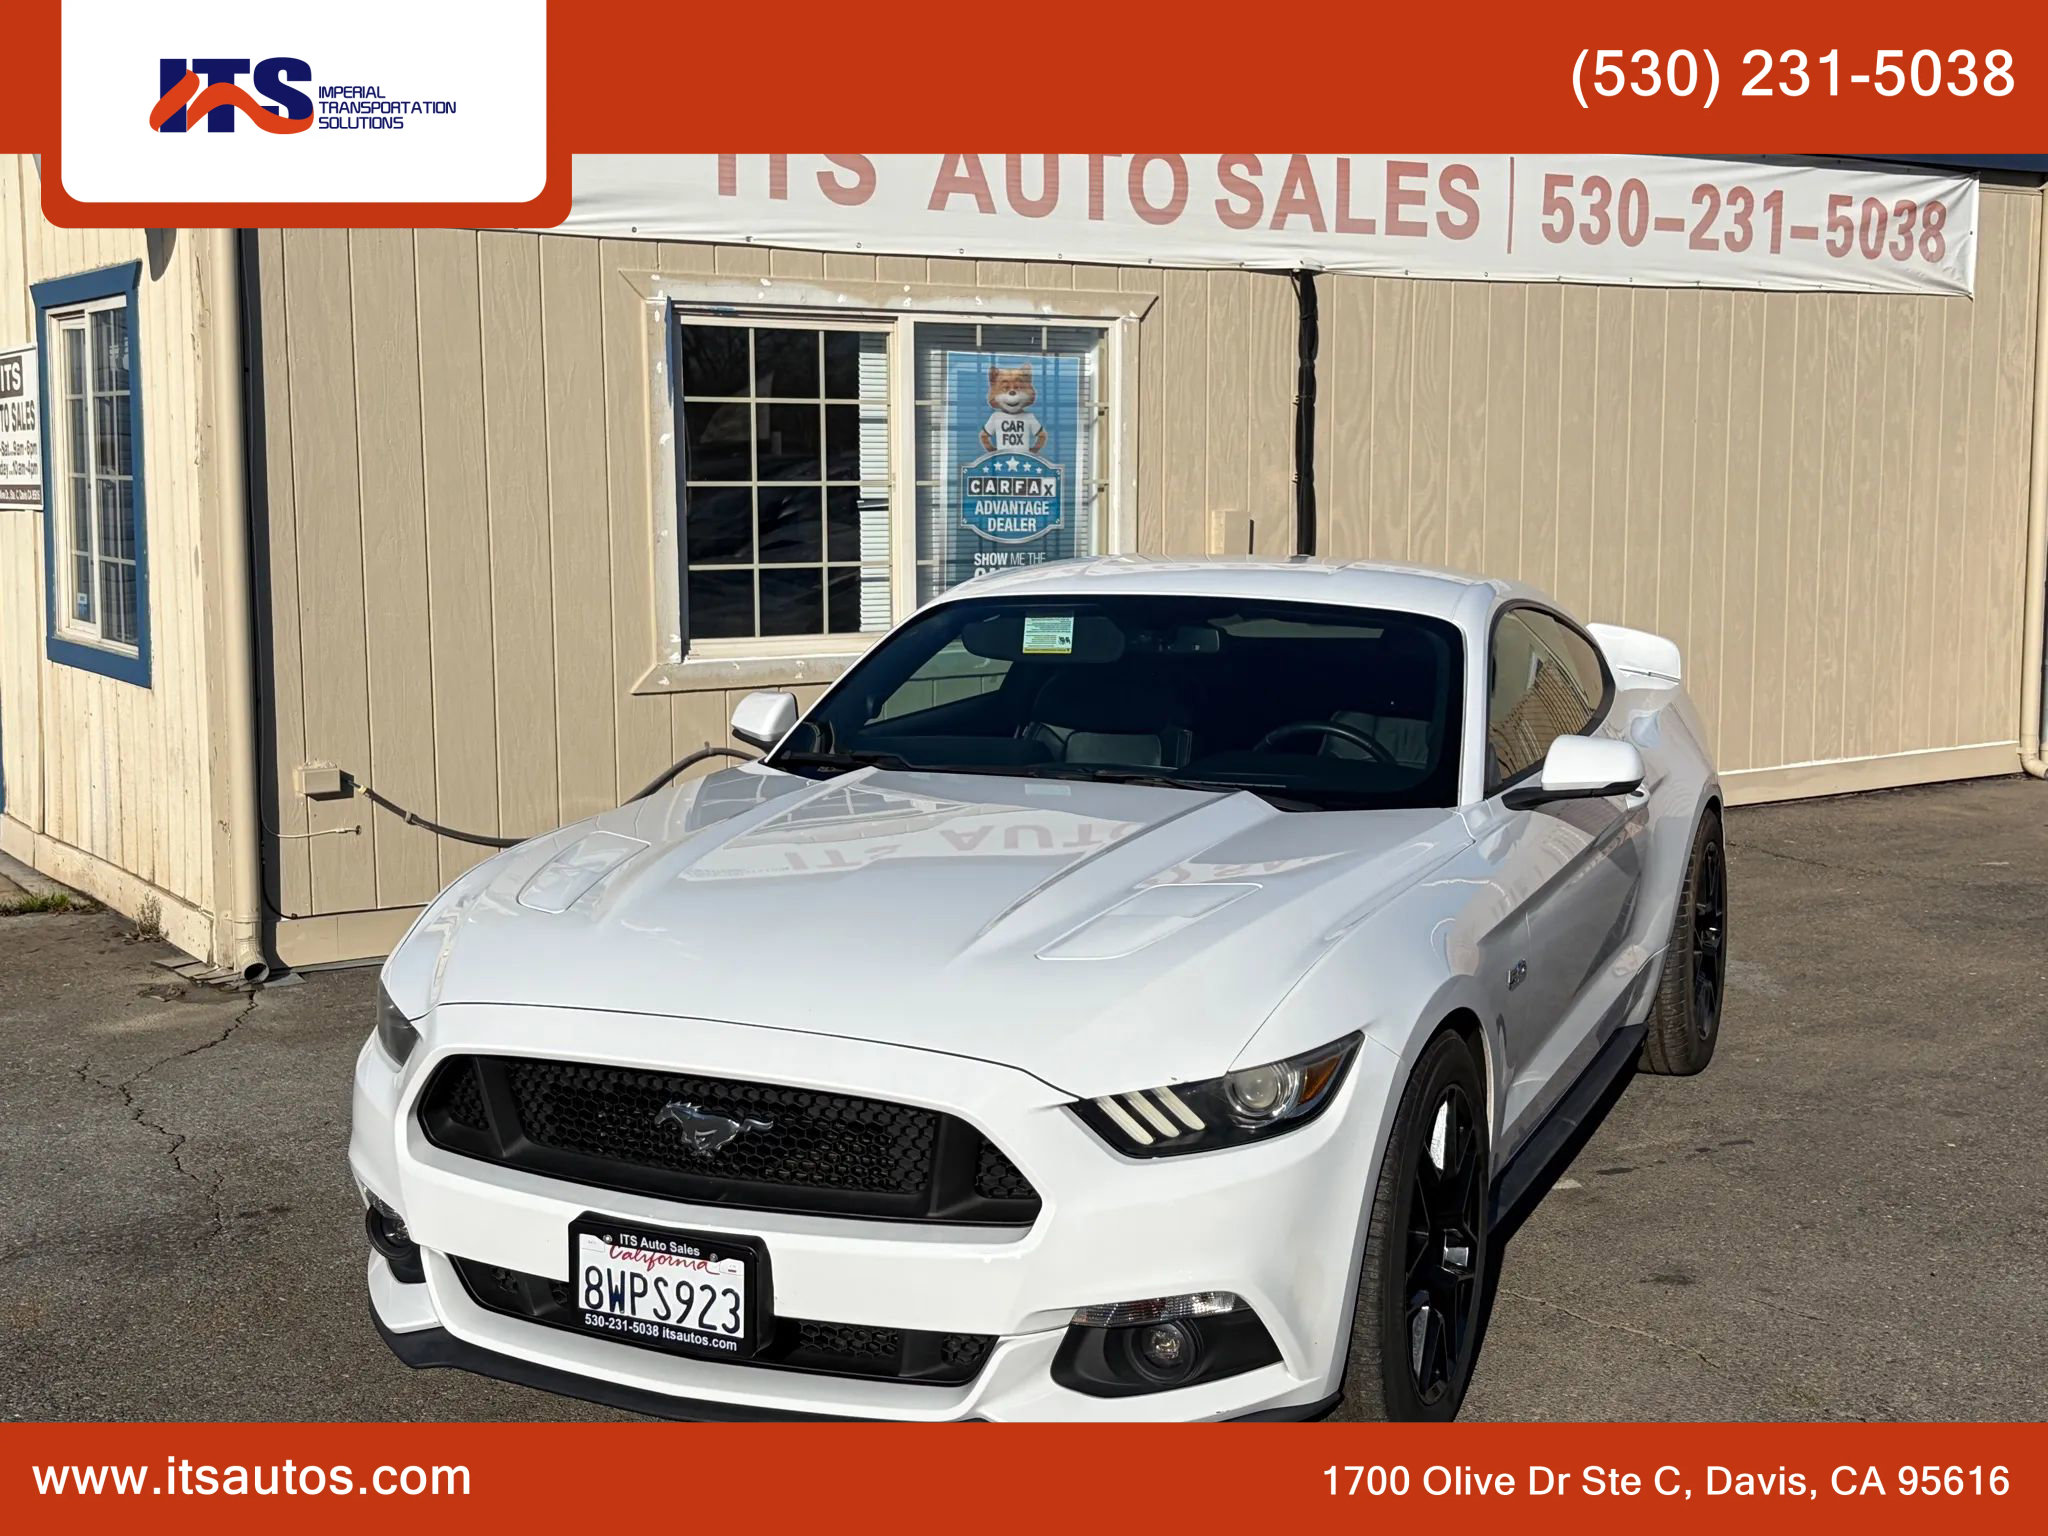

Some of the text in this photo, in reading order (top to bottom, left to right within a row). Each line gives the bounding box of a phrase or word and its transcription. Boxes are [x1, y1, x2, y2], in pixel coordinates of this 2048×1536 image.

[927, 153, 1190, 226] AUTO
[1214, 154, 1481, 242] SALES
[1541, 172, 1948, 263] 530-231-5038
[0, 361, 22, 392] ITS
[11, 399, 36, 433] SALES
[1001, 419, 1025, 433] CAR
[1002, 433, 1025, 446] FOX
[969, 478, 1055, 497] CARFAX
[974, 500, 1050, 516] ADVANTAGE
[987, 517, 1037, 532] DEALER
[974, 552, 1046, 566] SHOW ME THE
[619, 1233, 638, 1247] ITS
[640, 1237, 667, 1252] Auto
[669, 1241, 700, 1257] Sales
[609, 1245, 720, 1275] California
[584, 1265, 742, 1334] 8WPS923
[584, 1313, 738, 1351] 530-231-5038 itsautos.com
